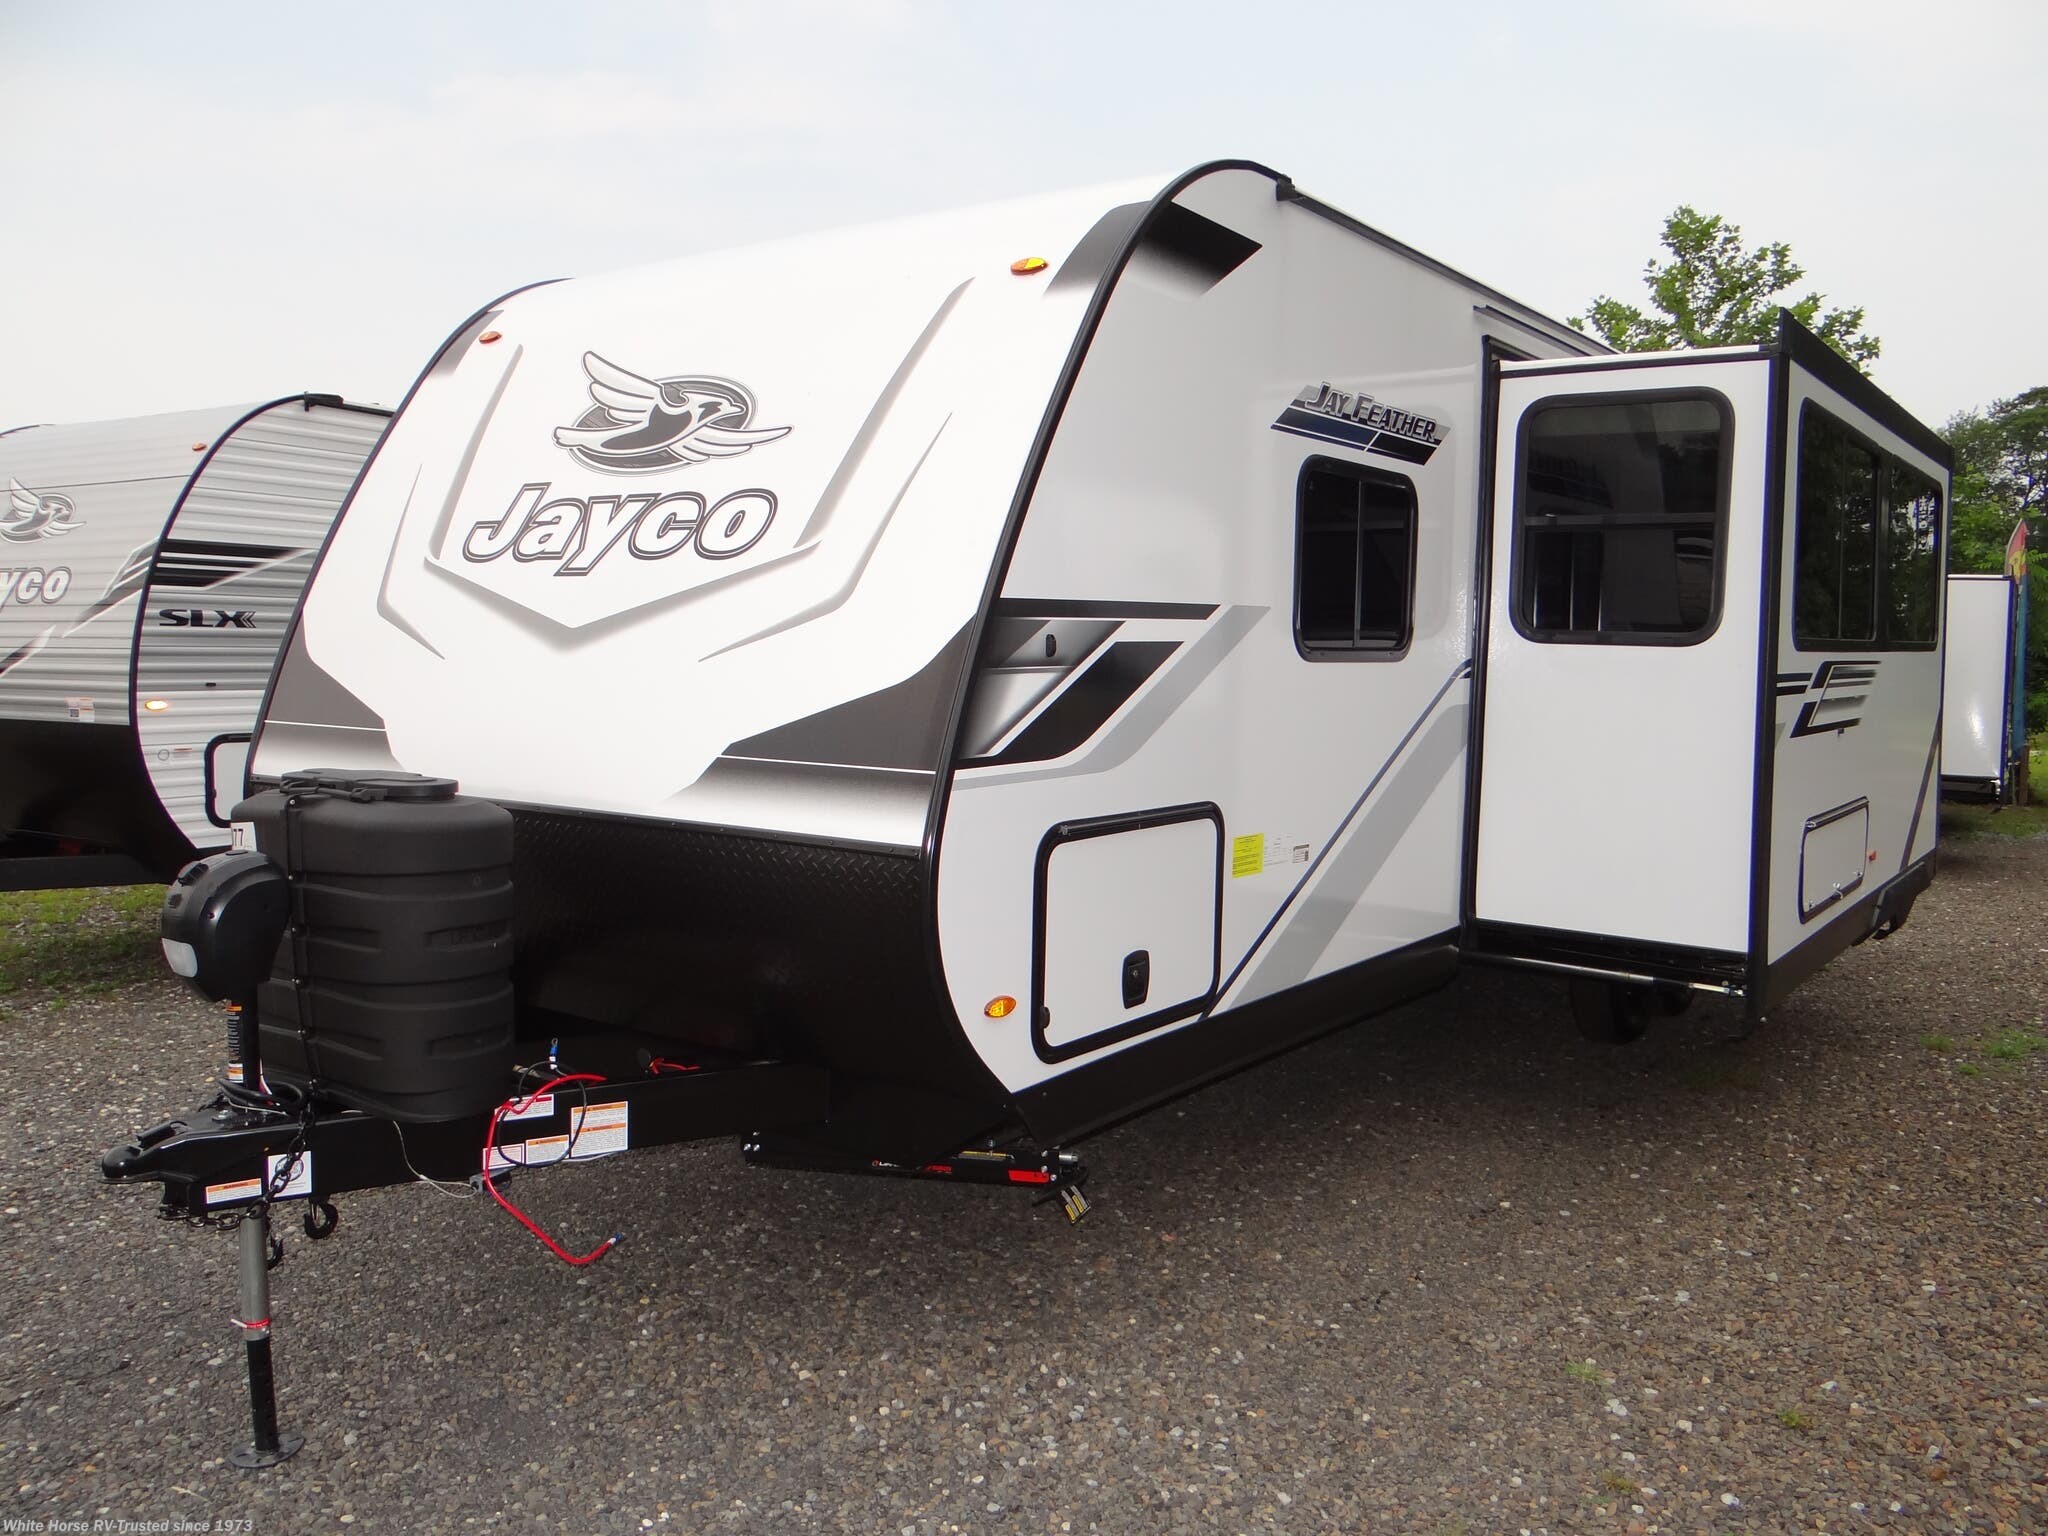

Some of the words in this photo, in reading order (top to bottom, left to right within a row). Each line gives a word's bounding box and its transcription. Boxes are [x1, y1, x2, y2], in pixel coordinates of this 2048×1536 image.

[1306, 382, 1353, 417] JAY
[1352, 393, 1436, 442] FEATHER
[463, 482, 778, 577] Jayco
[159, 609, 256, 628] SLX
